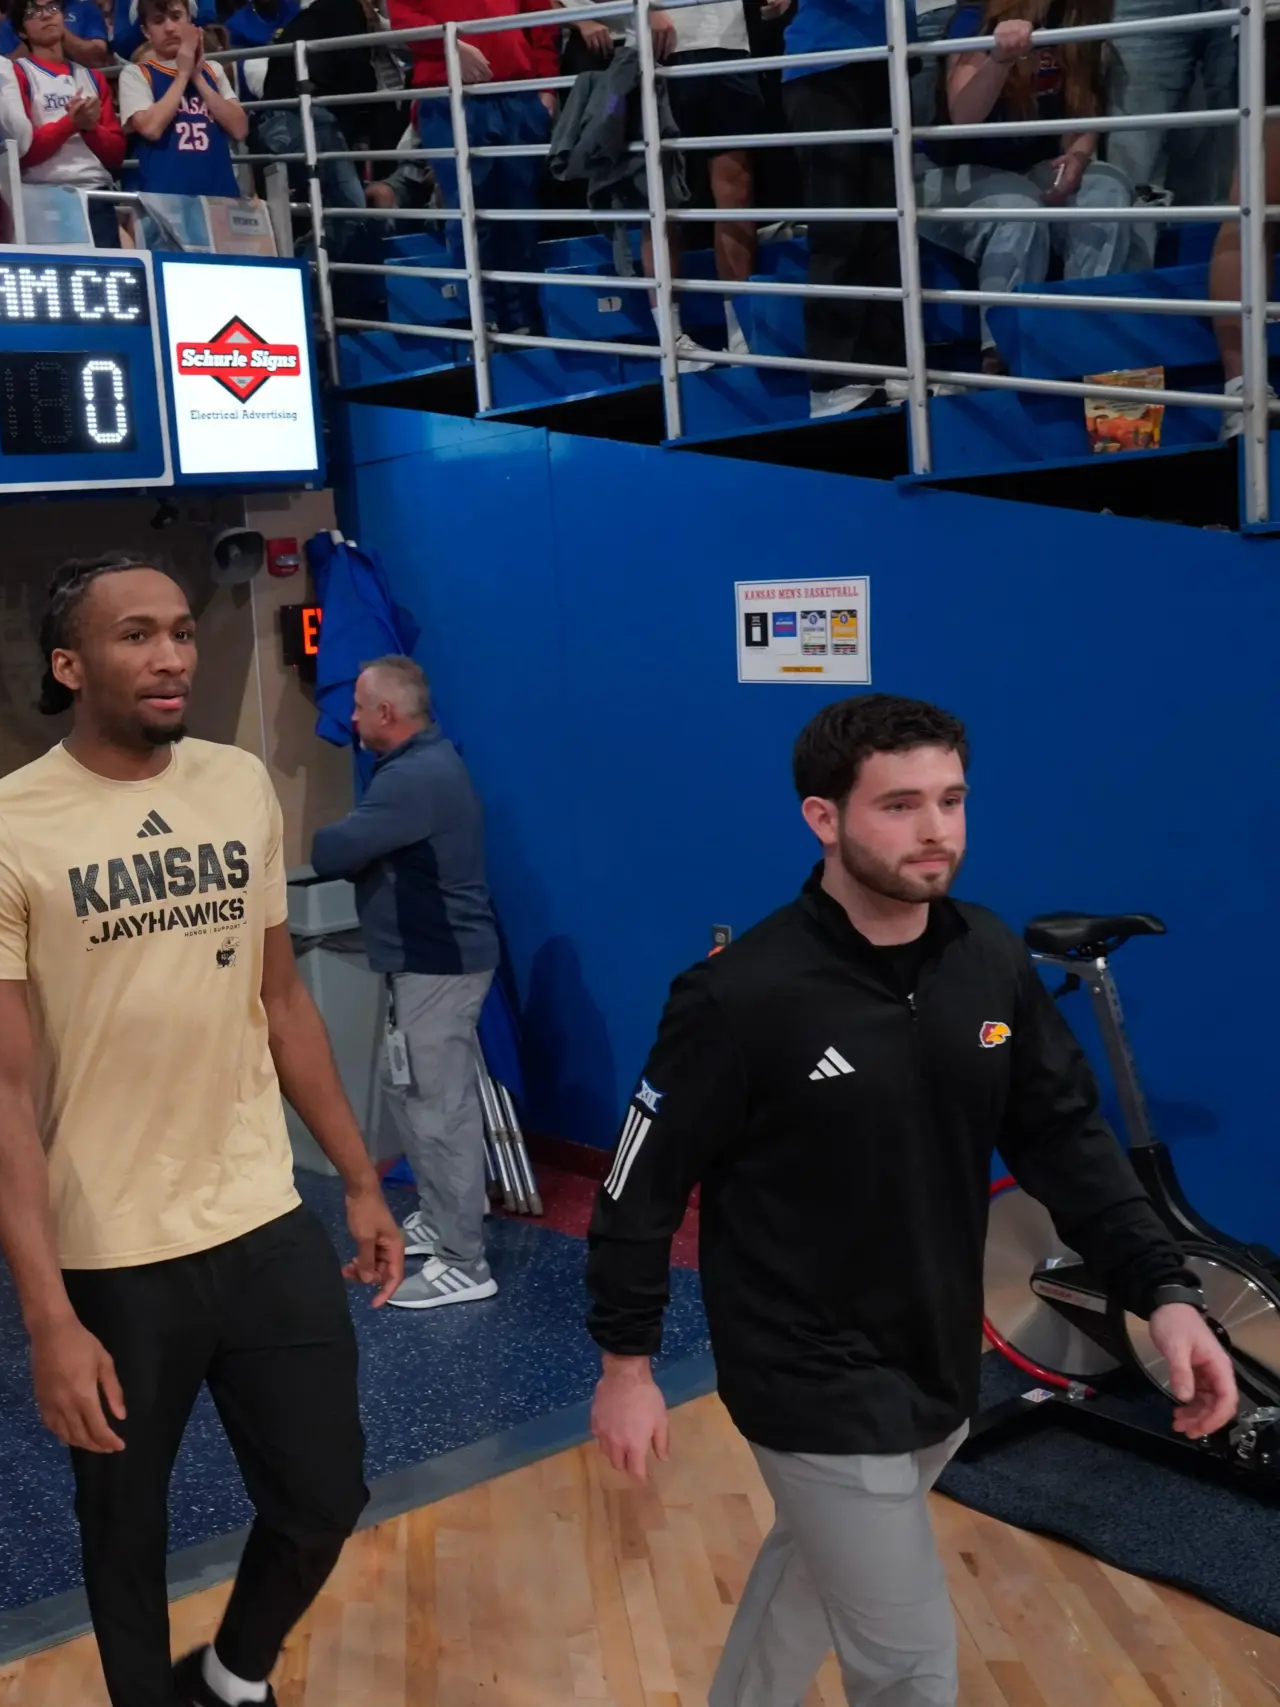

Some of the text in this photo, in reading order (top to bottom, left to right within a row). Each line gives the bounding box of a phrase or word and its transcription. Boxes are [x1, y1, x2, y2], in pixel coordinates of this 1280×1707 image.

[175, 121, 210, 151] 25
[181, 348, 297, 372] Schurle Signs
[82, 360, 127, 443] 0
[190, 409, 298, 421] Electrical Advertising
[744, 588, 776, 600] KANSAS
[804, 586, 859, 598] BASKETBALL
[68, 840, 249, 917] KANSAS
[89, 897, 245, 944] JAYHAWKS
